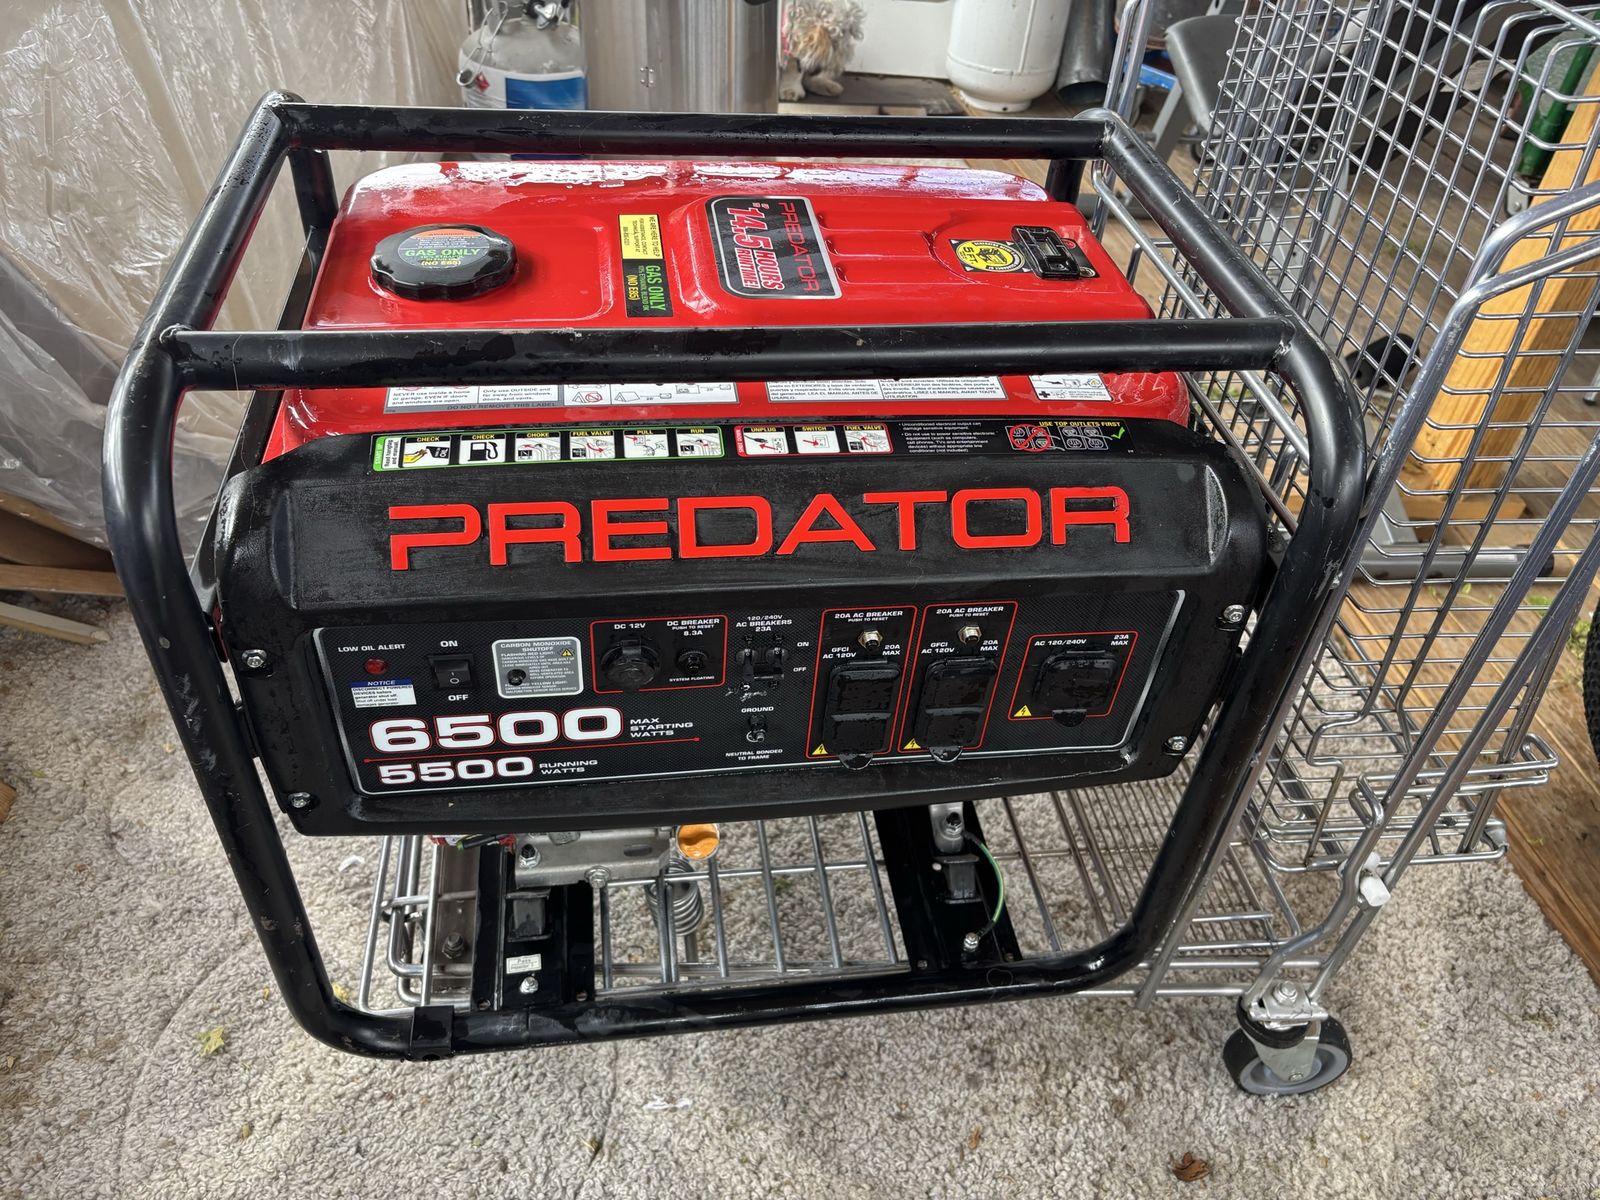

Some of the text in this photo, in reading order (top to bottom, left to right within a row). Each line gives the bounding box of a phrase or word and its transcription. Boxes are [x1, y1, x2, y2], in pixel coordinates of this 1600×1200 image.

[727, 207, 773, 250] 14.5
[778, 202, 819, 291] PREDATOR
[735, 248, 760, 288] RUNTIME!
[753, 250, 785, 290] HOURS
[626, 275, 640, 300] (NO E85)
[646, 265, 666, 310] GAS ONLY
[440, 448, 448, 457] OIL
[388, 486, 1132, 571] PREDATOR
[370, 706, 624, 753] 6500
[630, 722, 693, 731] STARTING
[630, 730, 674, 738] WATTS
[379, 756, 534, 785] 5500
[539, 759, 598, 769] RUNNING
[541, 766, 586, 775] WATTS
